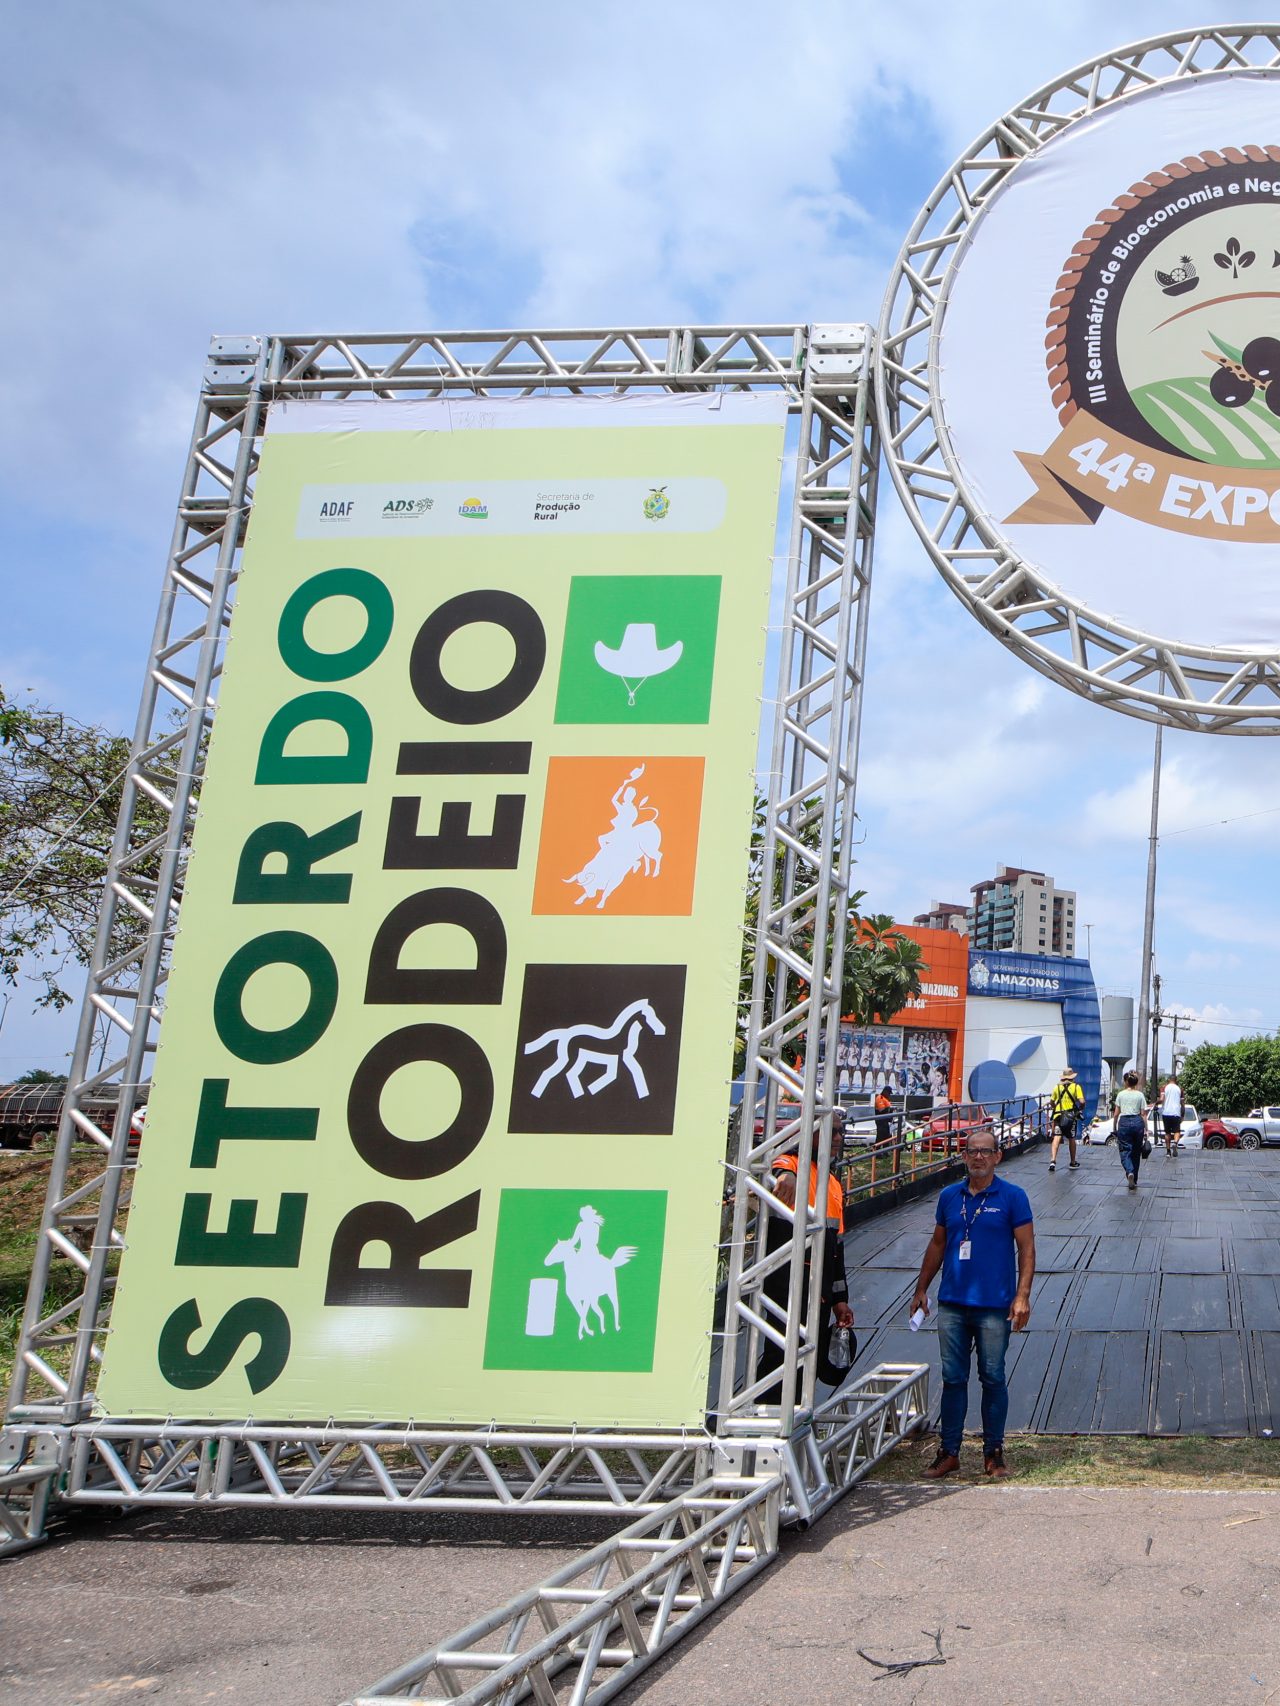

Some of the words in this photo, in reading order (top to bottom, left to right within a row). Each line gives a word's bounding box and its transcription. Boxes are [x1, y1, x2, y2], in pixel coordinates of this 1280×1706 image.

[1228, 182, 1240, 195] e
[1111, 185, 1224, 260] Bioeconomia
[1100, 260, 1121, 284] de
[1084, 287, 1109, 381] Seminário
[1088, 384, 1107, 404] III
[536, 493, 580, 501] Secretaria
[582, 492, 595, 501] de
[320, 501, 355, 517] ADAF
[383, 500, 416, 512] ADS
[458, 505, 488, 513] IDAM
[535, 502, 581, 512] Produção
[534, 512, 558, 520] Rural
[324, 590, 547, 1308] RODEIO
[992, 973, 1060, 989] AMAZONAS
[919, 982, 959, 998] MAZONAS
